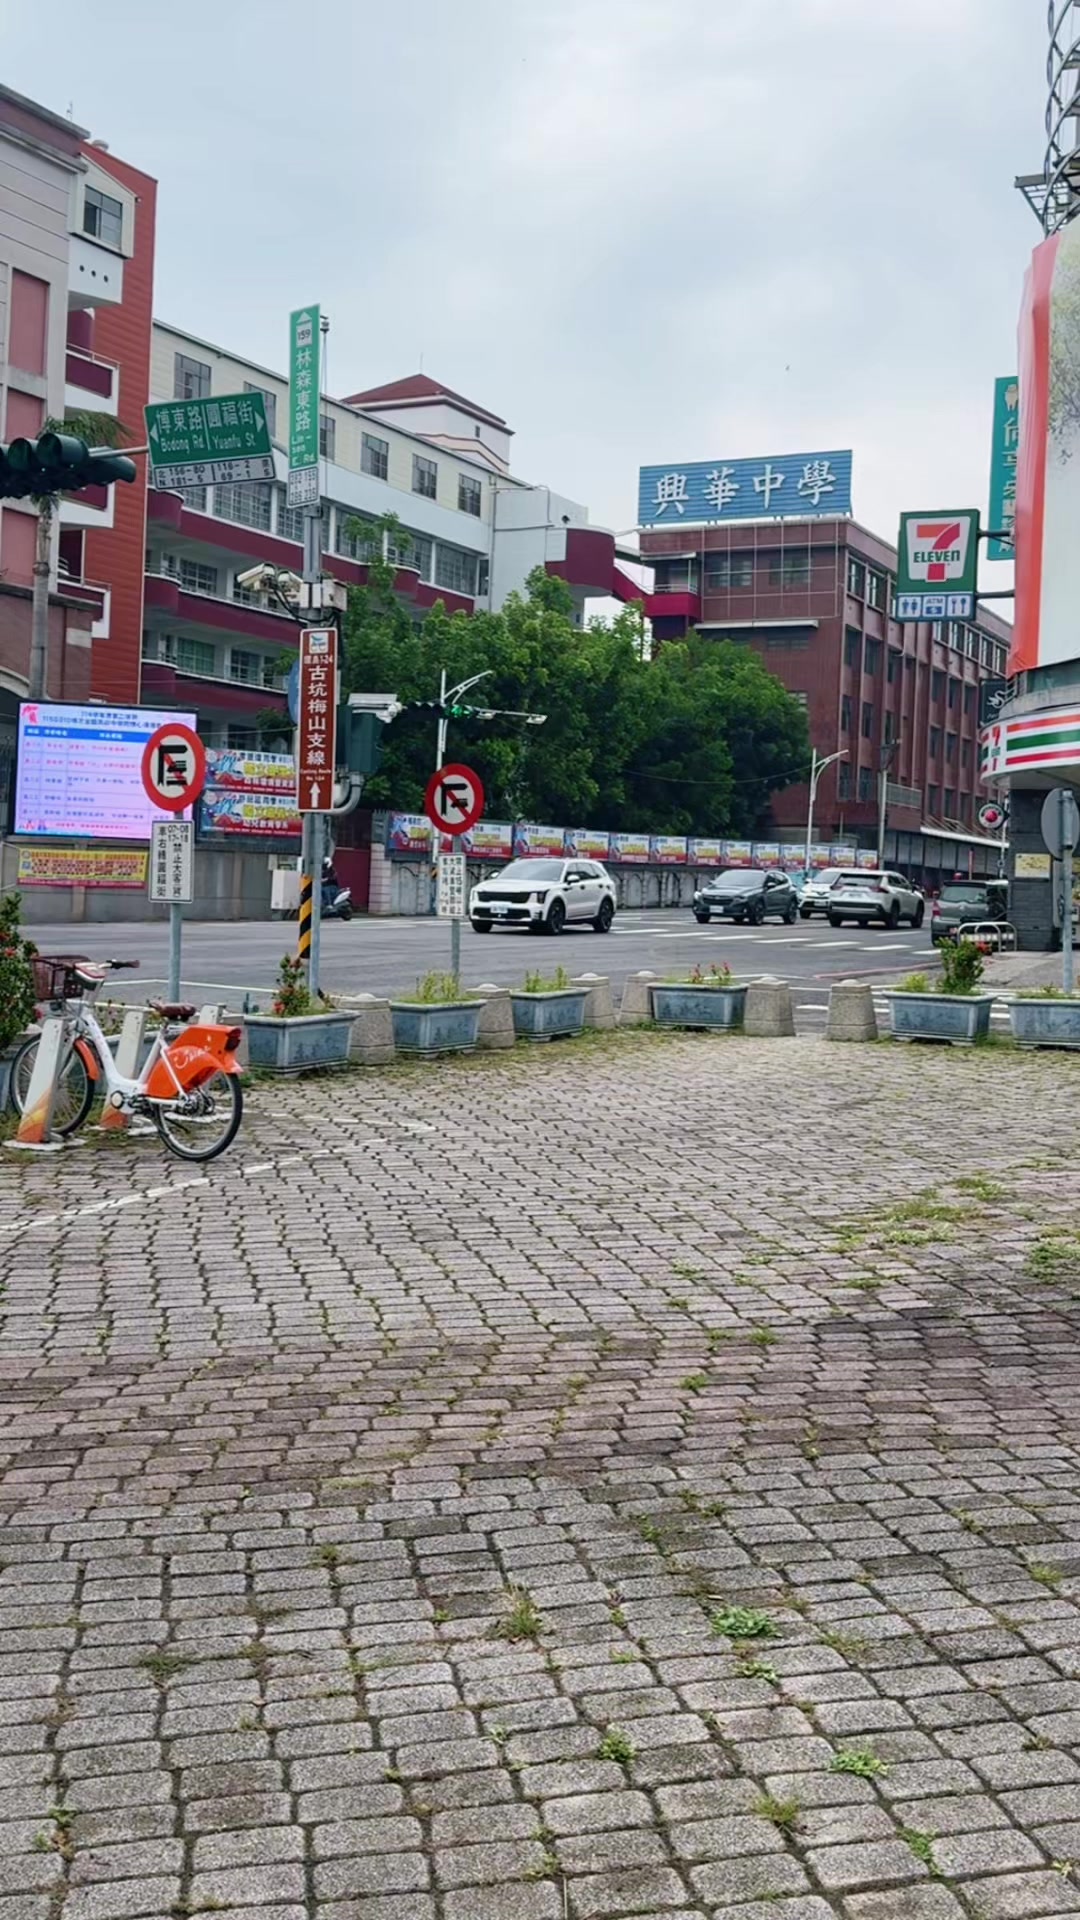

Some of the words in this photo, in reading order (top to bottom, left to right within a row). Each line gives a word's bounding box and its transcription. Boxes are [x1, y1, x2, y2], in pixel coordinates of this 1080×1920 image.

[297, 329, 311, 341] 159
[295, 347, 312, 432] 林森東路
[156, 406, 203, 434] 博東路
[211, 434, 241, 449] Yuanfu
[245, 432, 256, 447] St
[161, 438, 190, 454] Bodong
[192, 434, 204, 449] Rd
[651, 459, 837, 518] 興華中學
[917, 522, 961, 581] 7
[306, 665, 328, 766] 古坑梅山支線
